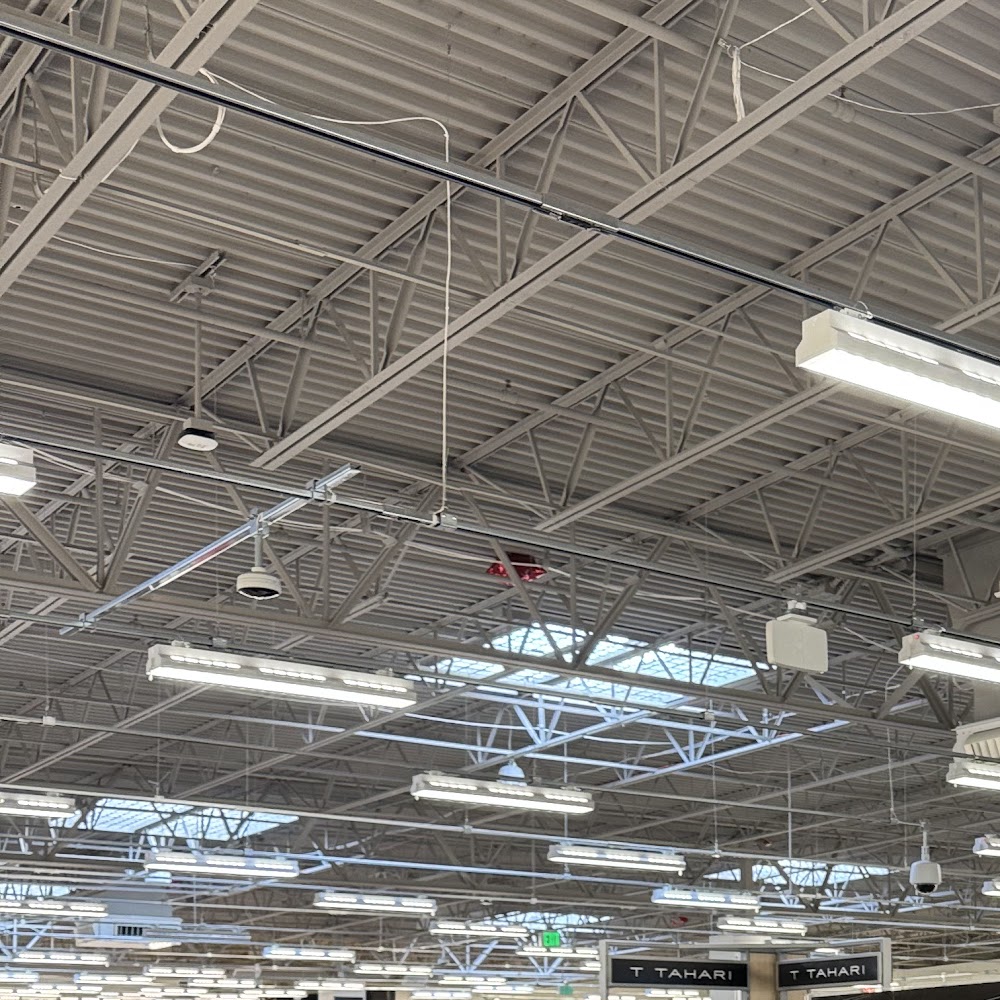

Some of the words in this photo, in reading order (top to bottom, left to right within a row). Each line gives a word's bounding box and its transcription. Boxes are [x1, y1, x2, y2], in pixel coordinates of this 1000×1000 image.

[630, 967, 644, 978] T
[654, 967, 733, 980] TAHARI
[789, 970, 800, 980] T
[806, 965, 866, 979] TAHARI
